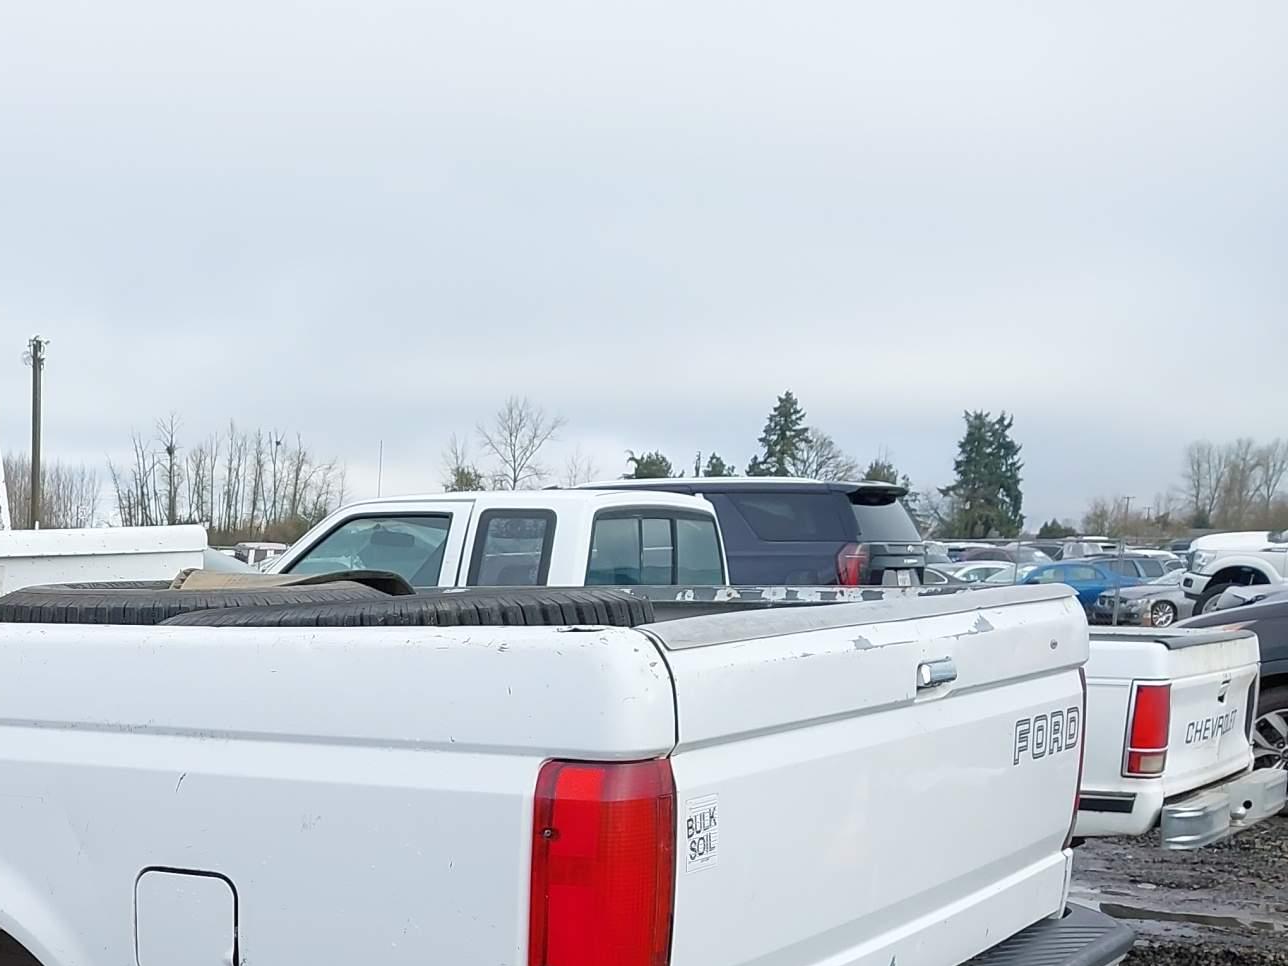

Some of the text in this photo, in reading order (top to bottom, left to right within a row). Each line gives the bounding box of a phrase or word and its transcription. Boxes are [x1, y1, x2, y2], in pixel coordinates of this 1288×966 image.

[1013, 706, 1080, 766] FORD
[686, 806, 717, 839] BULK
[689, 832, 716, 861] SOIL
